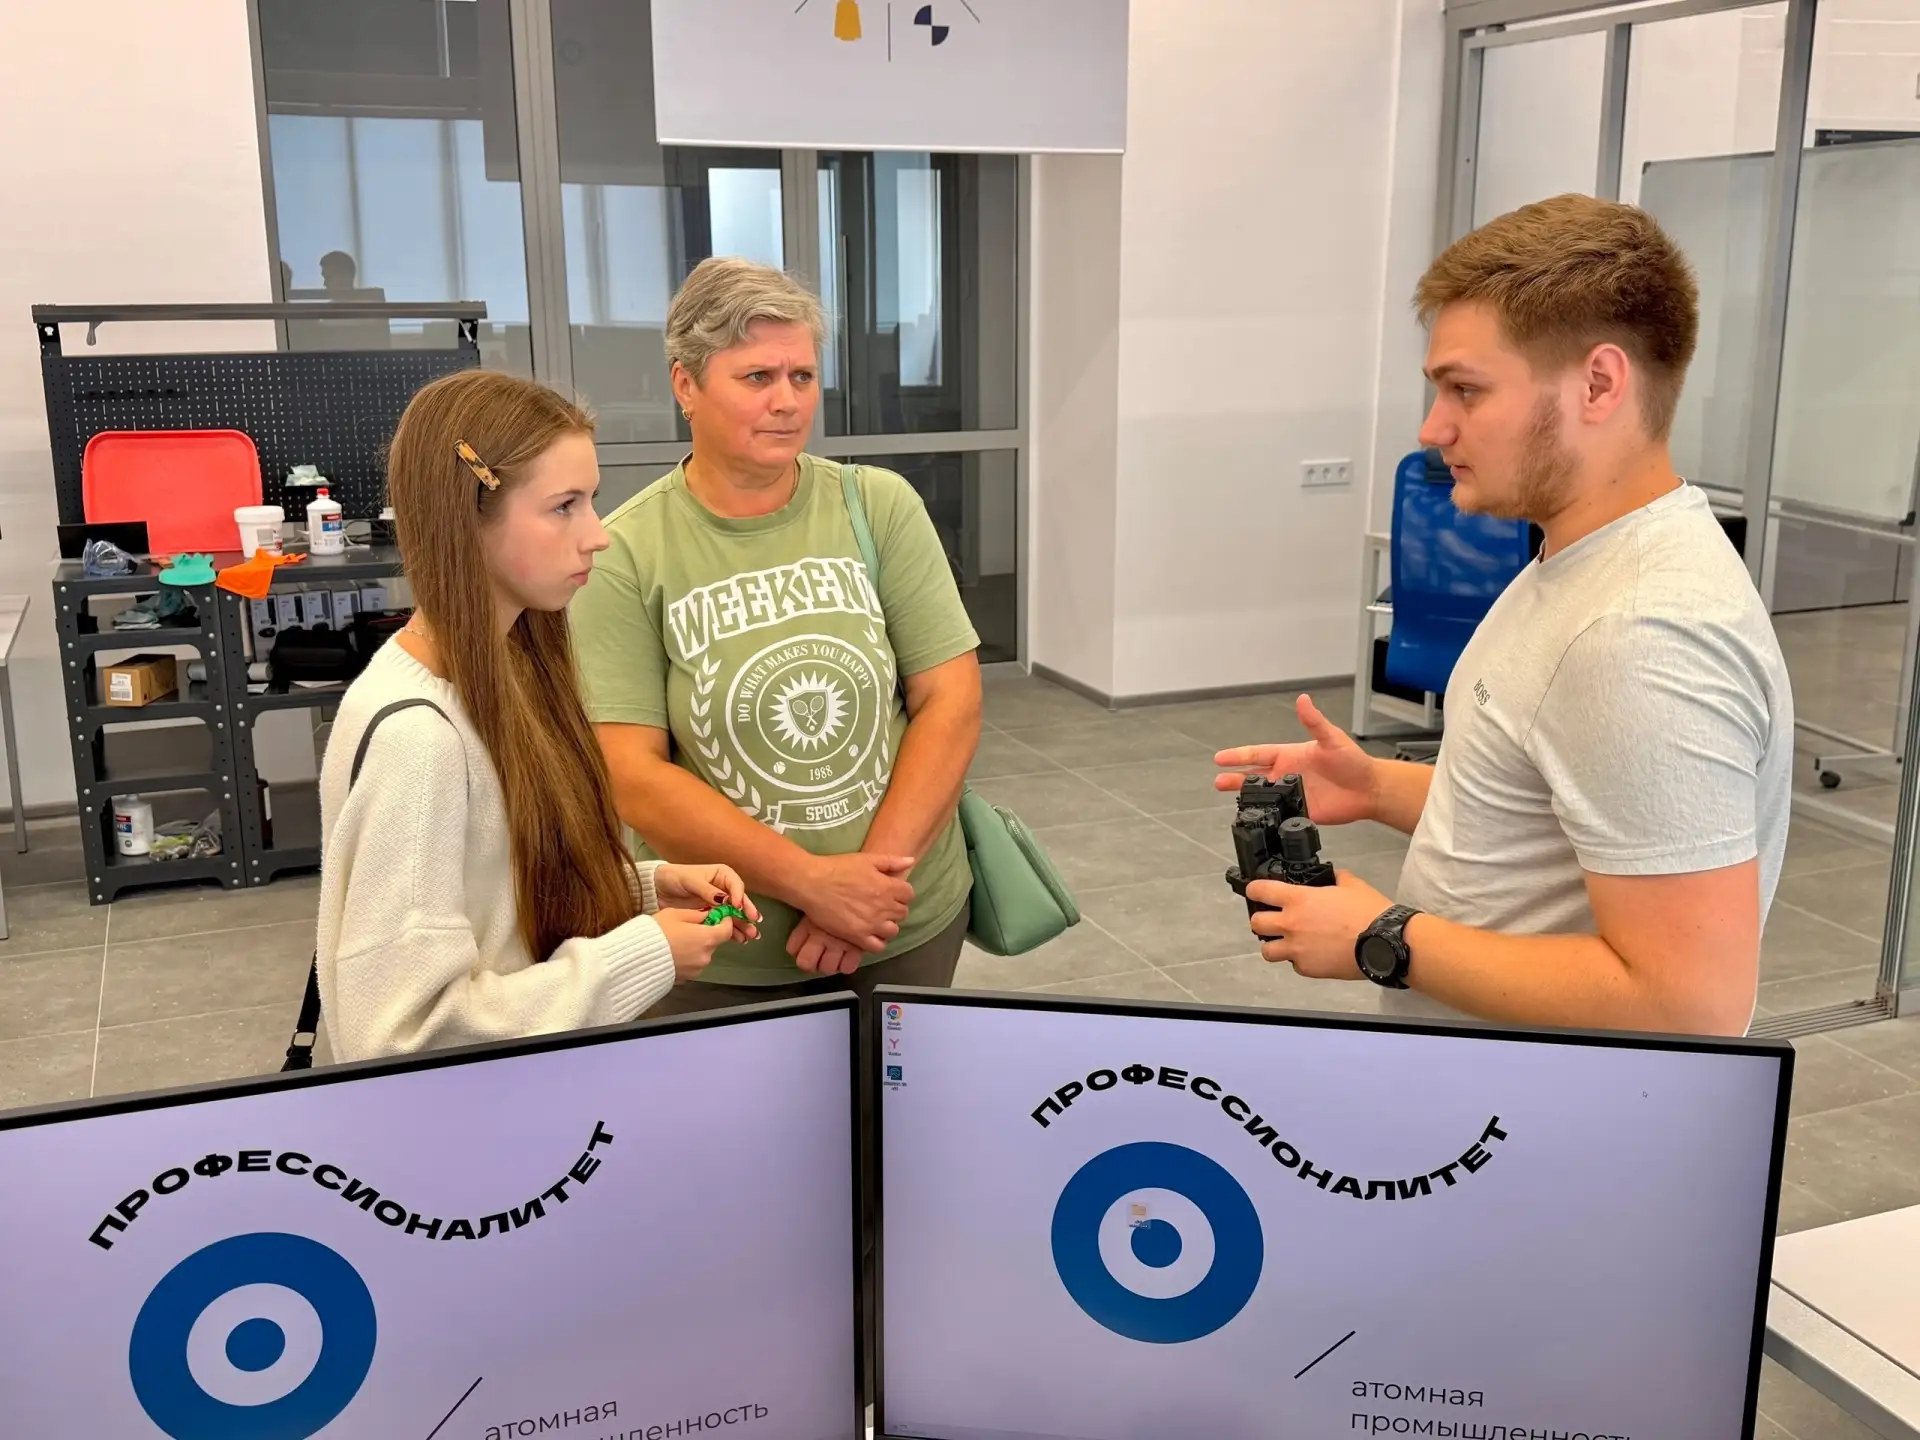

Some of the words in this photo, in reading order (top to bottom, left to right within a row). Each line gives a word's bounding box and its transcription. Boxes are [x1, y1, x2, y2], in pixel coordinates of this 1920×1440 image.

[764, 644, 809, 670] MAKES
[812, 643, 840, 659] YOU
[740, 664, 768, 699] WHAT
[839, 652, 873, 690] HAPPY
[1473, 677, 1491, 706] BOSS
[737, 703, 751, 723] DO
[809, 765, 833, 781] 1988
[805, 798, 850, 821] SPORT
[1031, 1064, 1510, 1201] ПРОФЕССИОНАЛИТЕТ
[88, 1120, 615, 1251] ПРОФЕССИОНАЛИТЕТ
[1351, 1381, 1484, 1407] атомная
[485, 1401, 618, 1440] атомная
